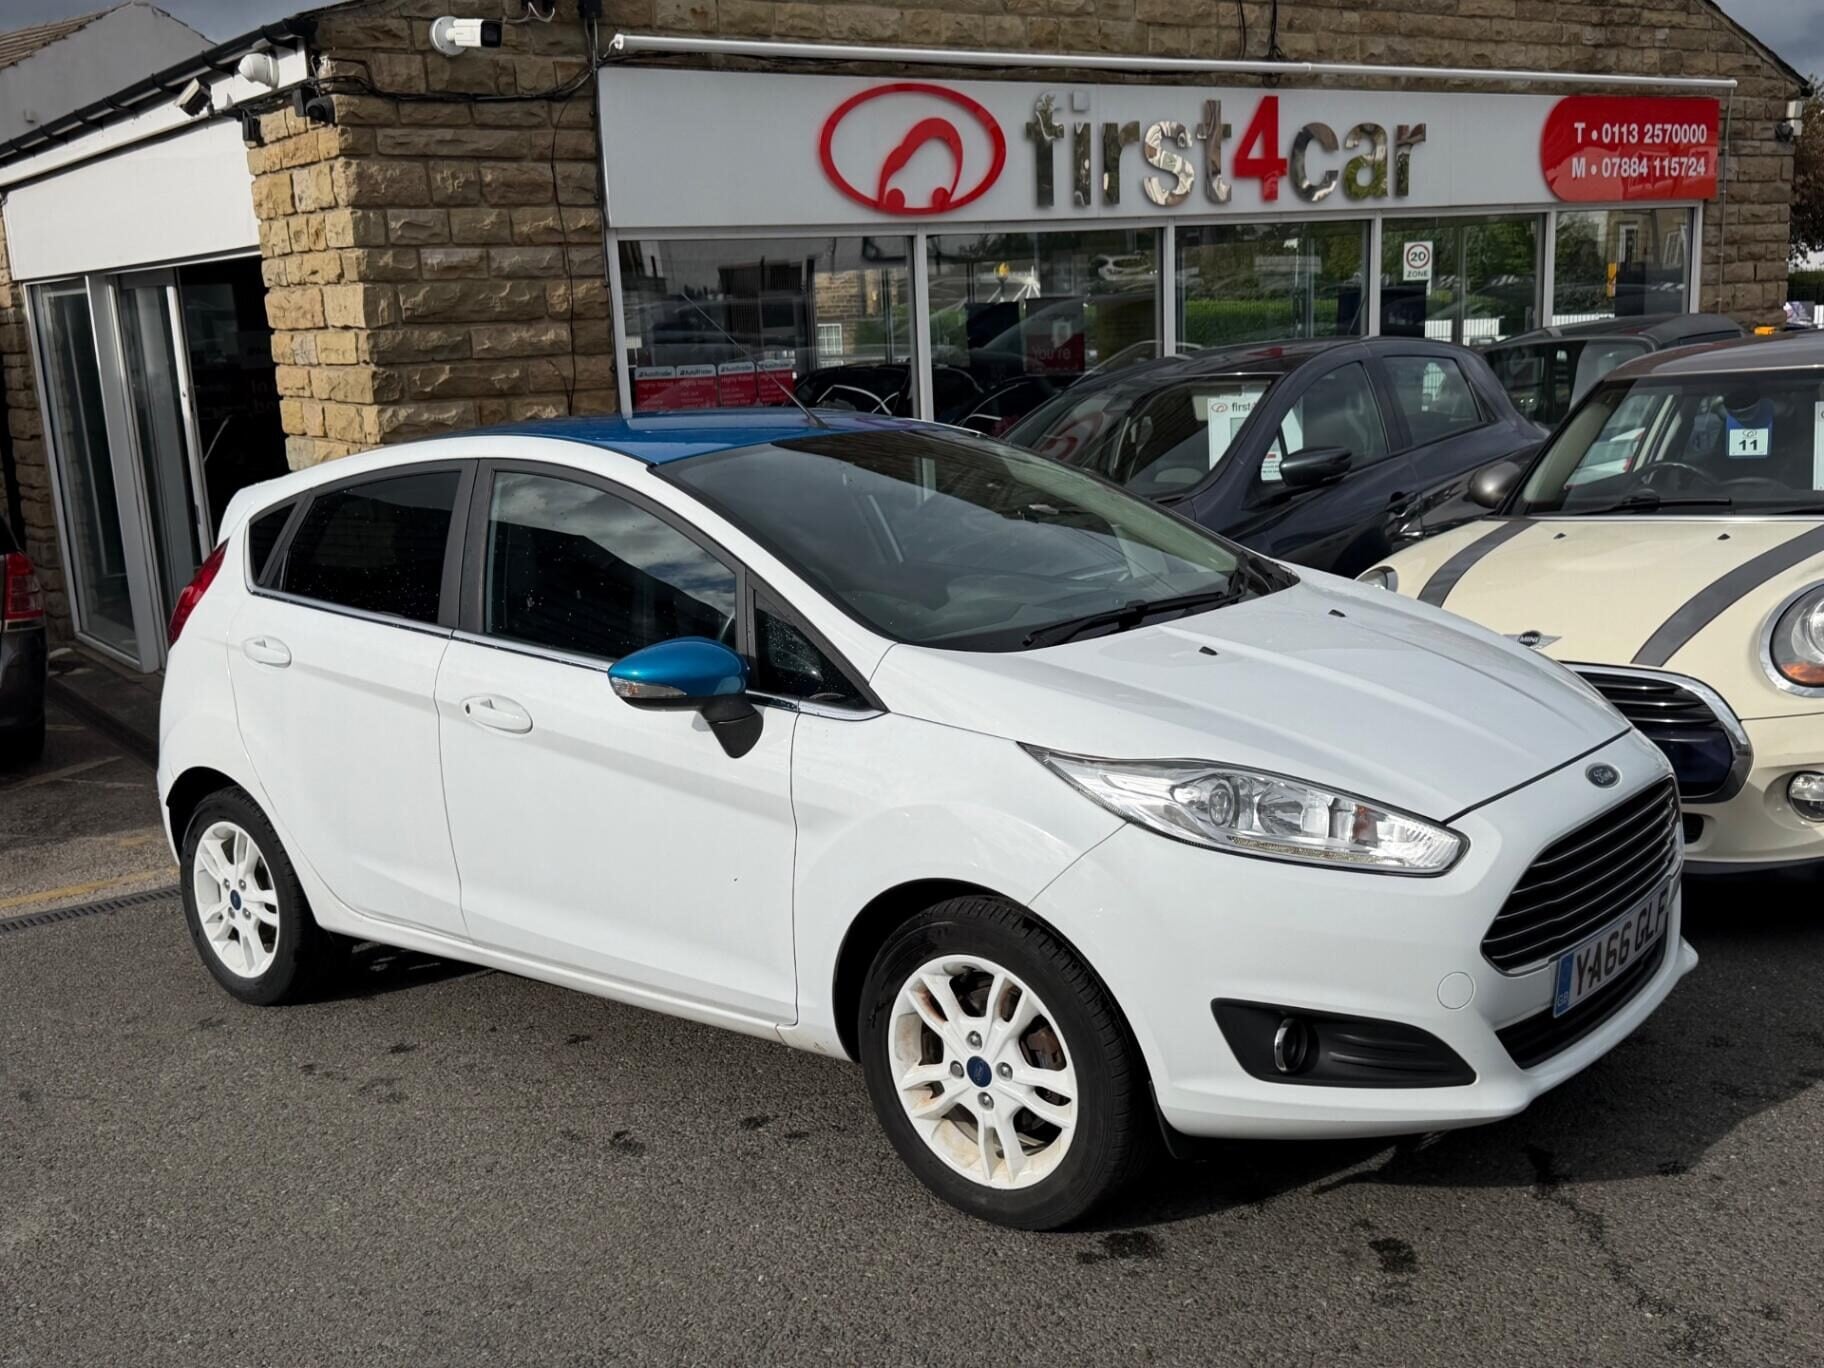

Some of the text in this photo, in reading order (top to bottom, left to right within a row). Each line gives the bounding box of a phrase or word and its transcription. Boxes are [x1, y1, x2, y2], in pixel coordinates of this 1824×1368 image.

[1574, 122, 1707, 144] T 0113 2570000
[1025, 90, 1426, 208] first4car
[1572, 157, 1705, 178] M 07884 115724
[1410, 251, 1427, 262] 20
[1406, 270, 1428, 278] ZONE
[1739, 439, 1757, 451] 11
[1576, 920, 1633, 996] YA66
